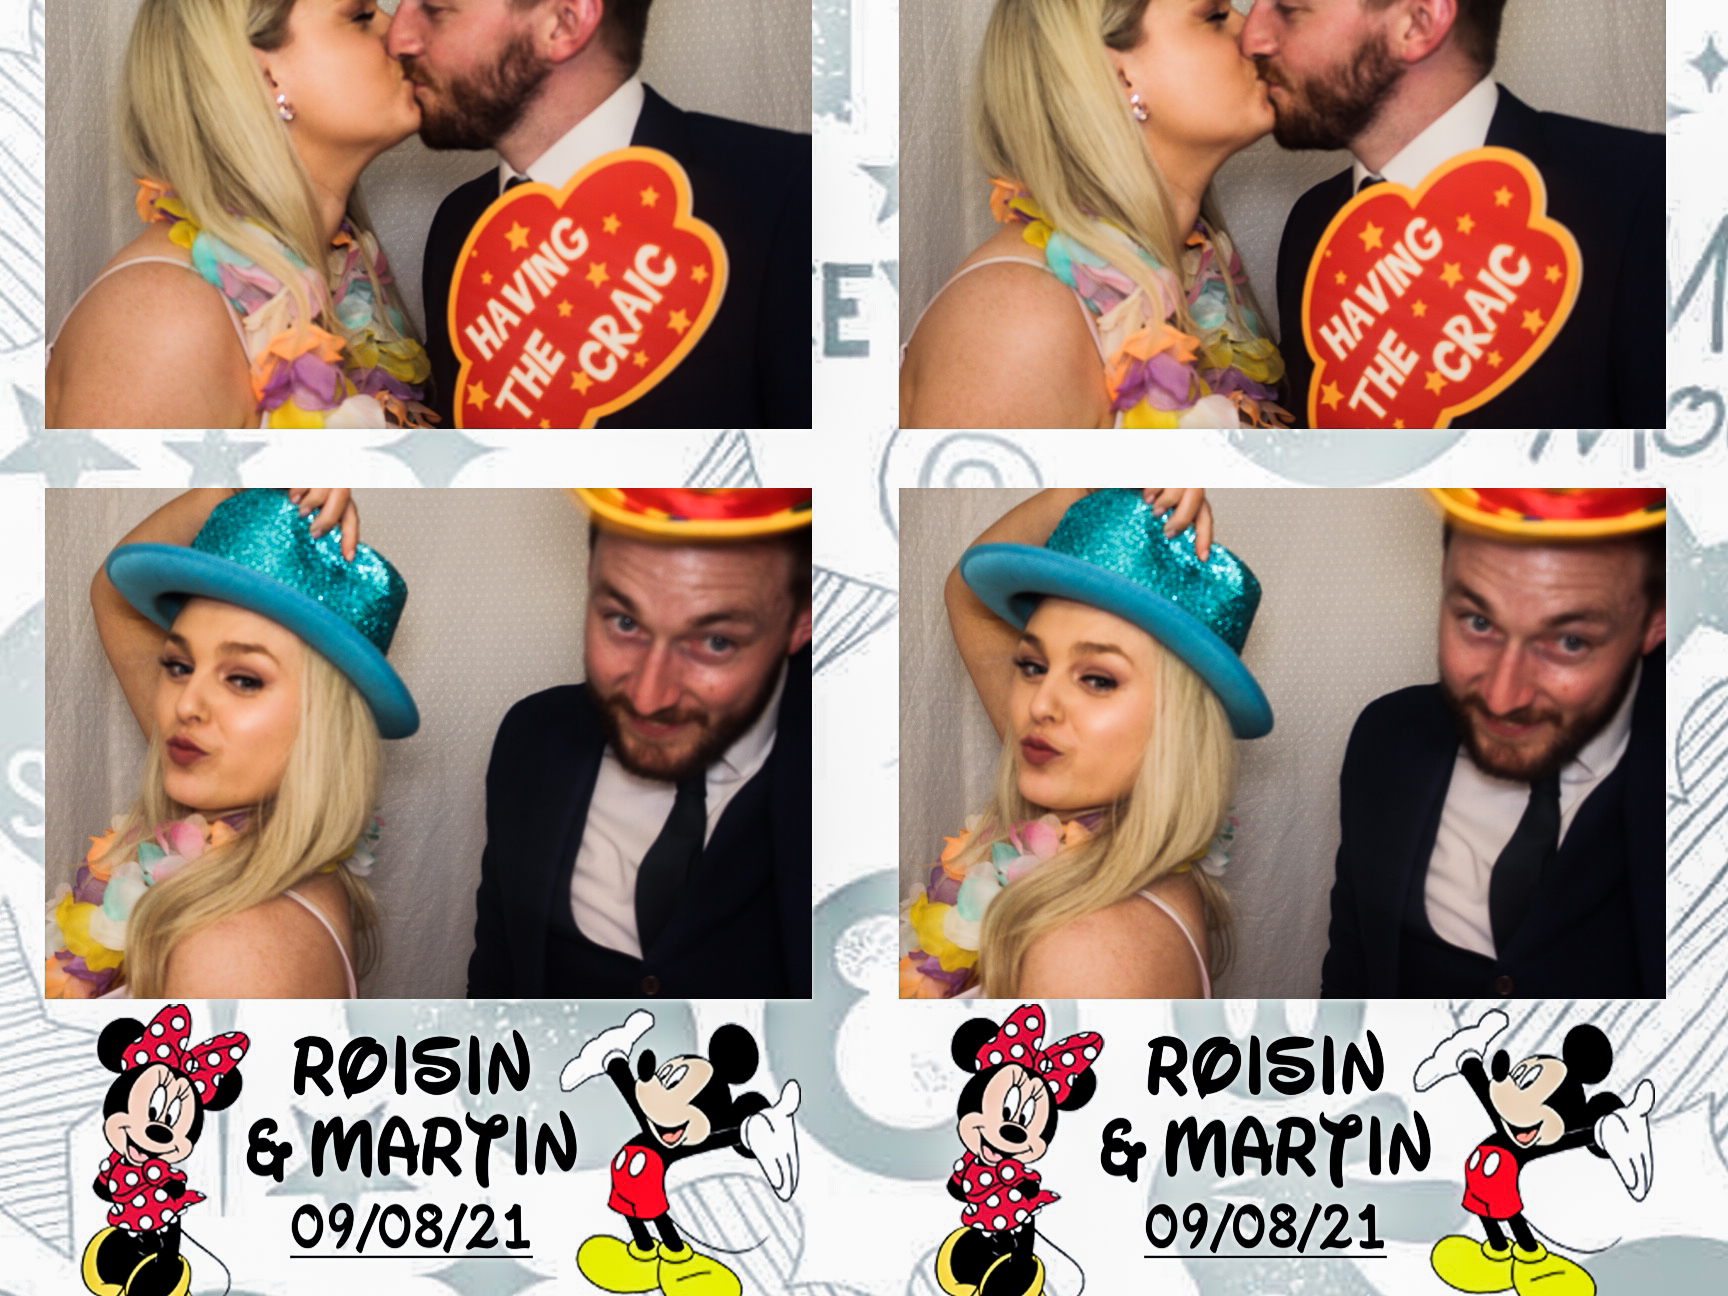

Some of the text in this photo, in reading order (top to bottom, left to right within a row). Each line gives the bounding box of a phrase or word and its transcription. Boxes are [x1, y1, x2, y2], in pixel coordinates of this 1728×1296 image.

[464, 217, 589, 361] HAVING
[494, 328, 566, 419] THE
[578, 243, 677, 382] CRAIC
[1318, 217, 1443, 361] HAVING
[1348, 328, 1420, 419] THE
[1432, 243, 1531, 382] CRAIC
